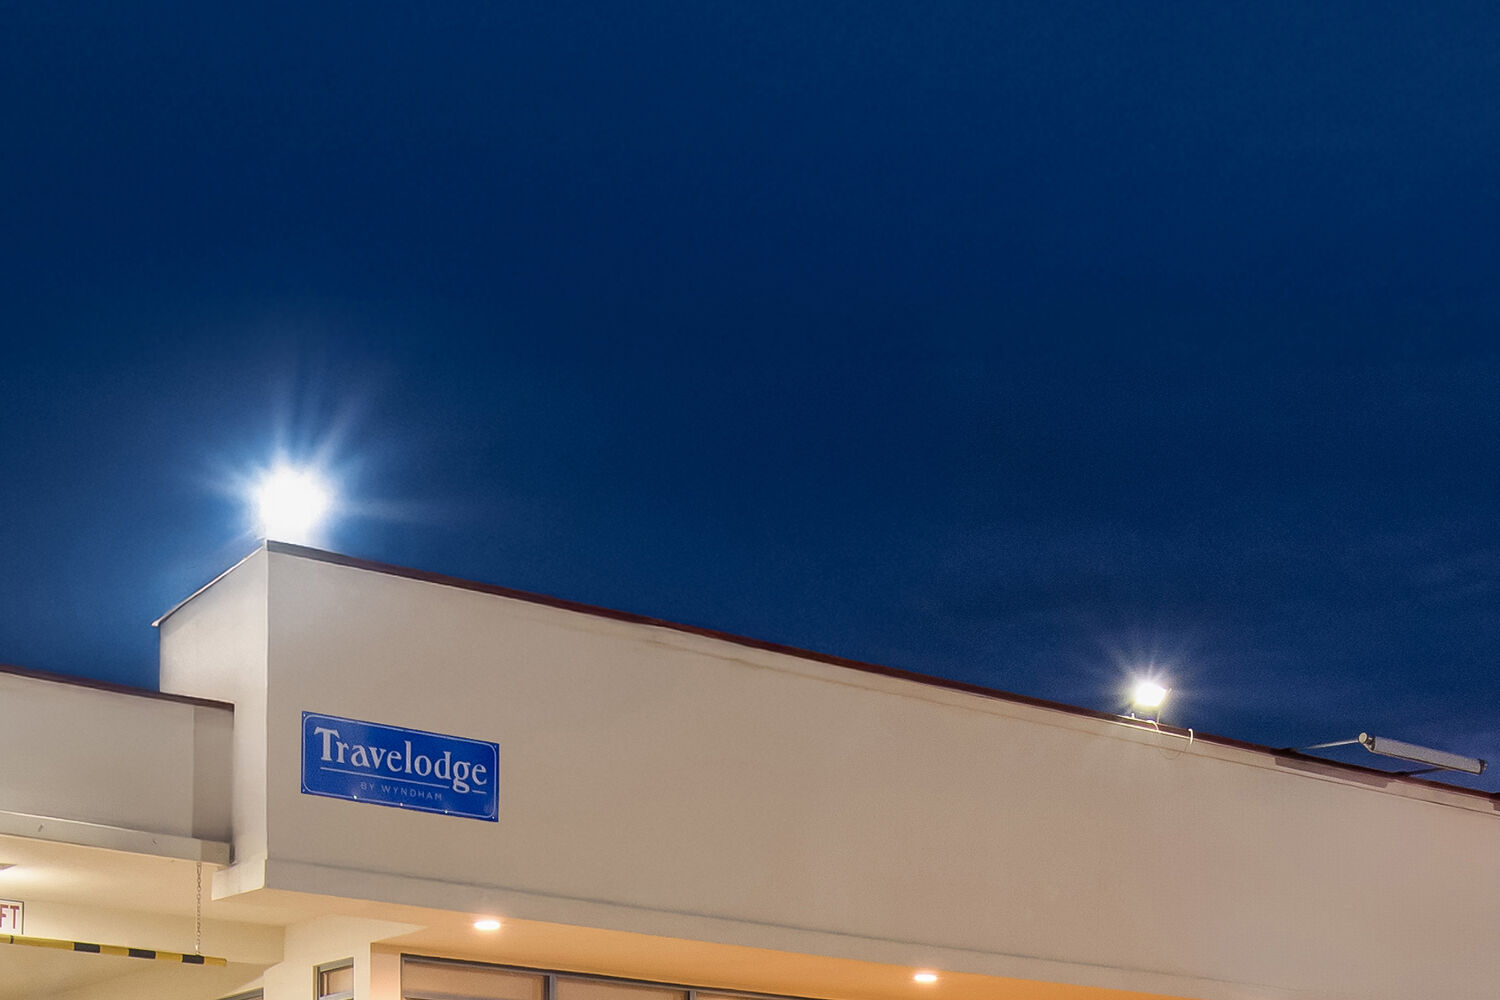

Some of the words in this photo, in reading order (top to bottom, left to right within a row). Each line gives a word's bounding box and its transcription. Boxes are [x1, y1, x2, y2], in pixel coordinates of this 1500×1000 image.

[314, 726, 487, 794] Travelodge
[360, 781, 375, 791] BY
[381, 784, 442, 801] WYNDHAM
